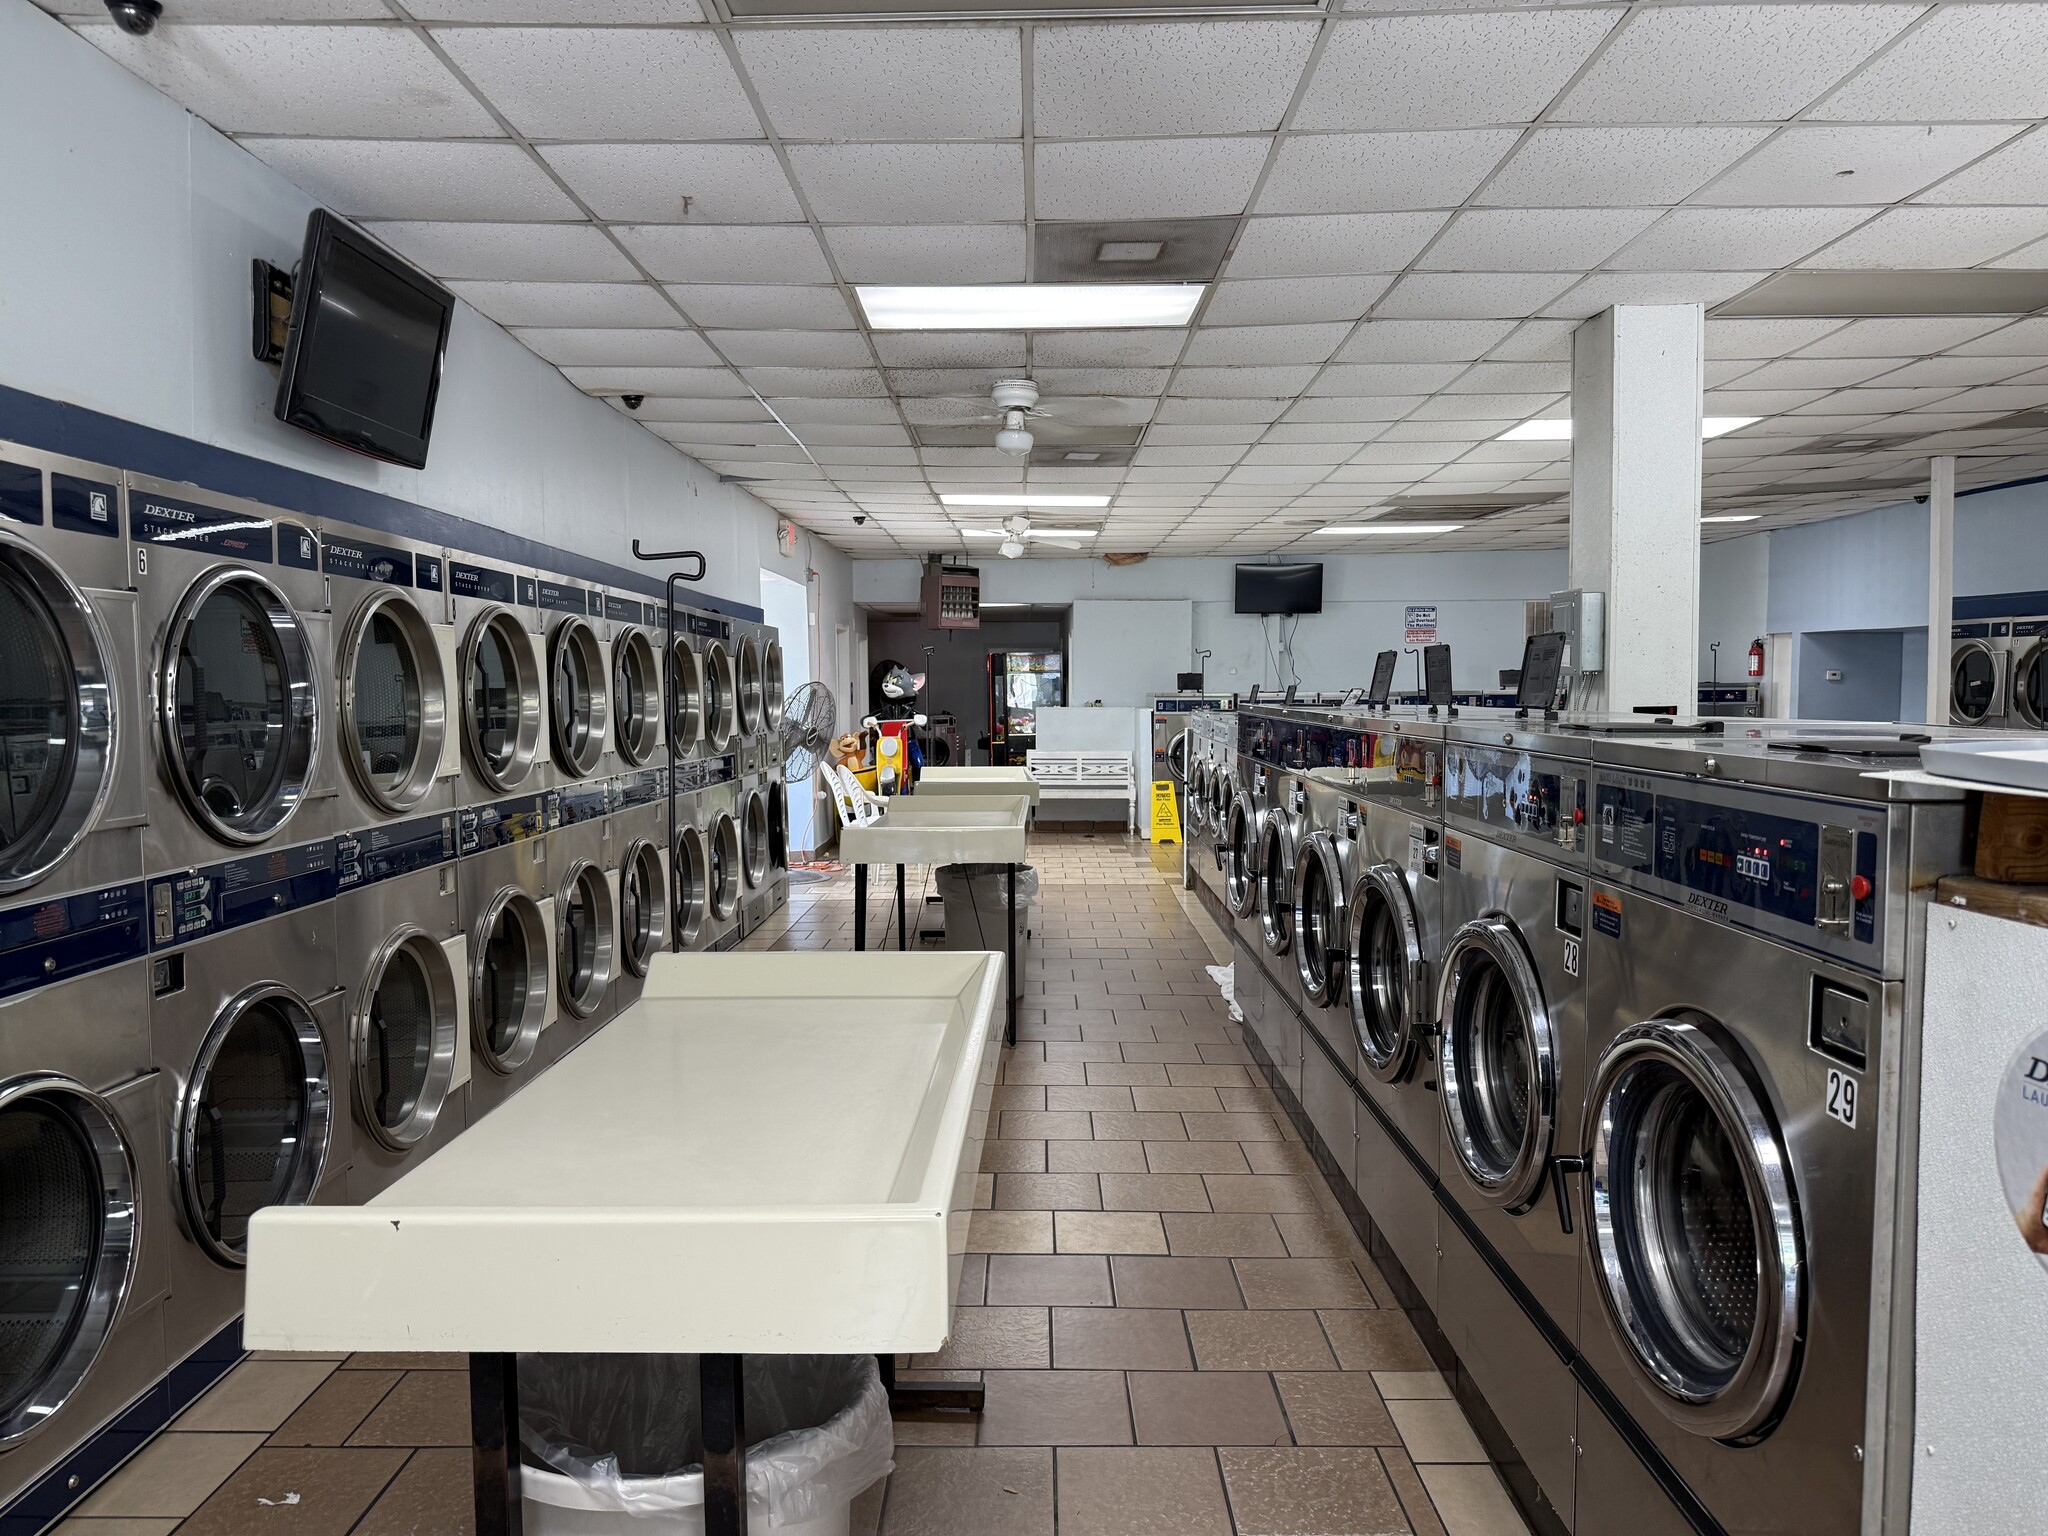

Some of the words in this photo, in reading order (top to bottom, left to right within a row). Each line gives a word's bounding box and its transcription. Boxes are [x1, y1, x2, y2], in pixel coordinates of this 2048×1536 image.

[144, 503, 196, 523] DEXTER
[139, 550, 146, 573] 6
[329, 558, 353, 568] STACK
[330, 545, 363, 559] DEXTER
[455, 571, 479, 582] DEXTER
[324, 576, 330, 605] 7
[1687, 892, 1729, 915] DEXTER
[1565, 941, 1578, 974] 28
[1828, 1071, 1855, 1123] 29
